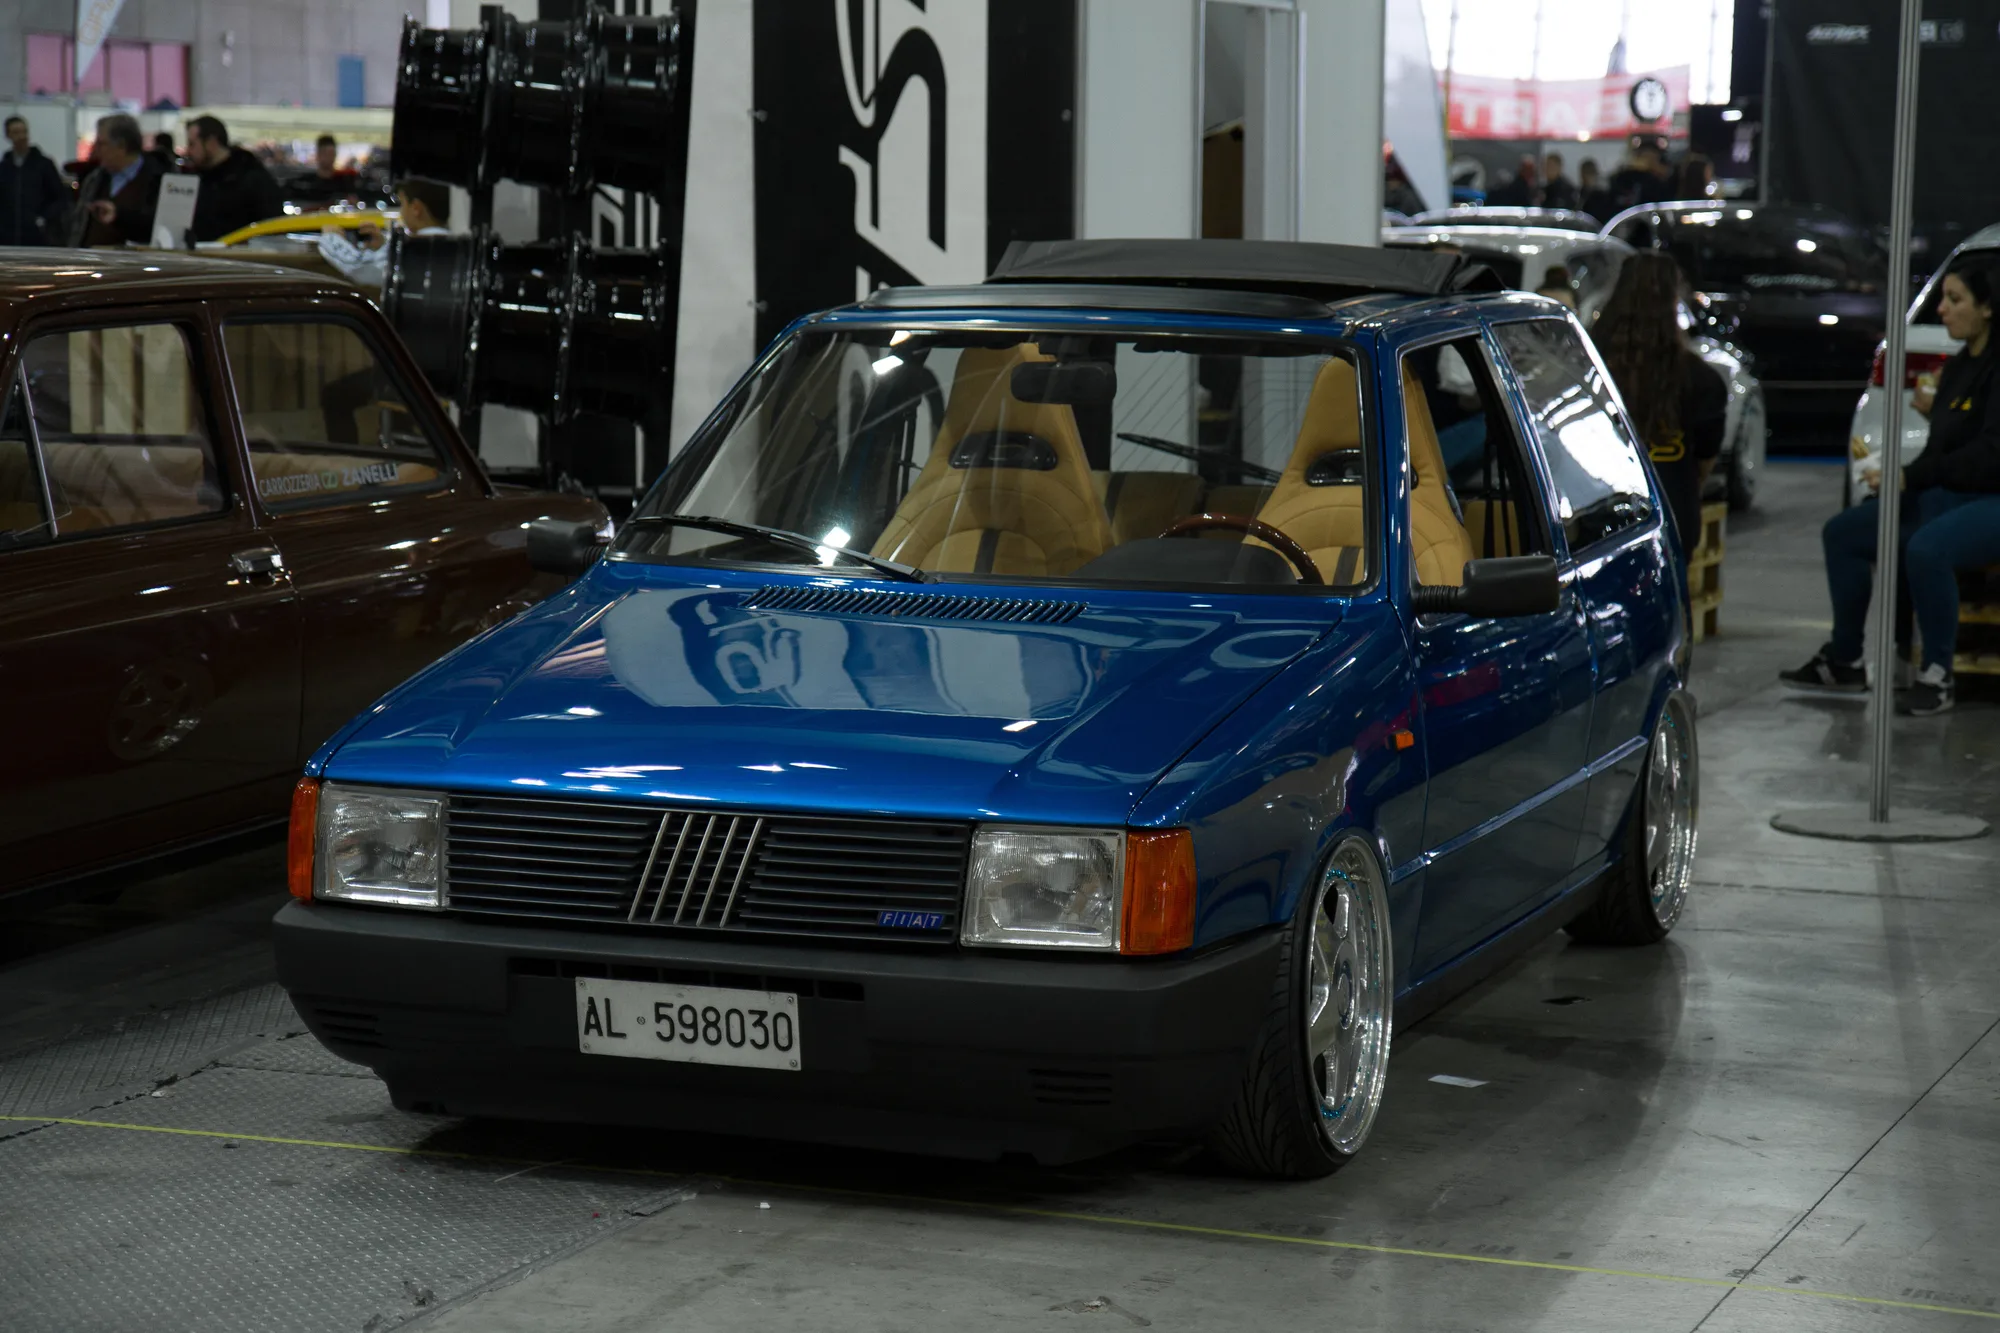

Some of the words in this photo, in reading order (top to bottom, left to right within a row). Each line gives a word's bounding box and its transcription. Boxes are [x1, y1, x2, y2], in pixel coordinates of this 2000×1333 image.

[259, 473, 323, 497] CARROZZERIA
[342, 463, 398, 486] ZANELLI
[883, 912, 940, 927] FIAT
[584, 996, 627, 1039] AL
[654, 1002, 793, 1051] 598030
